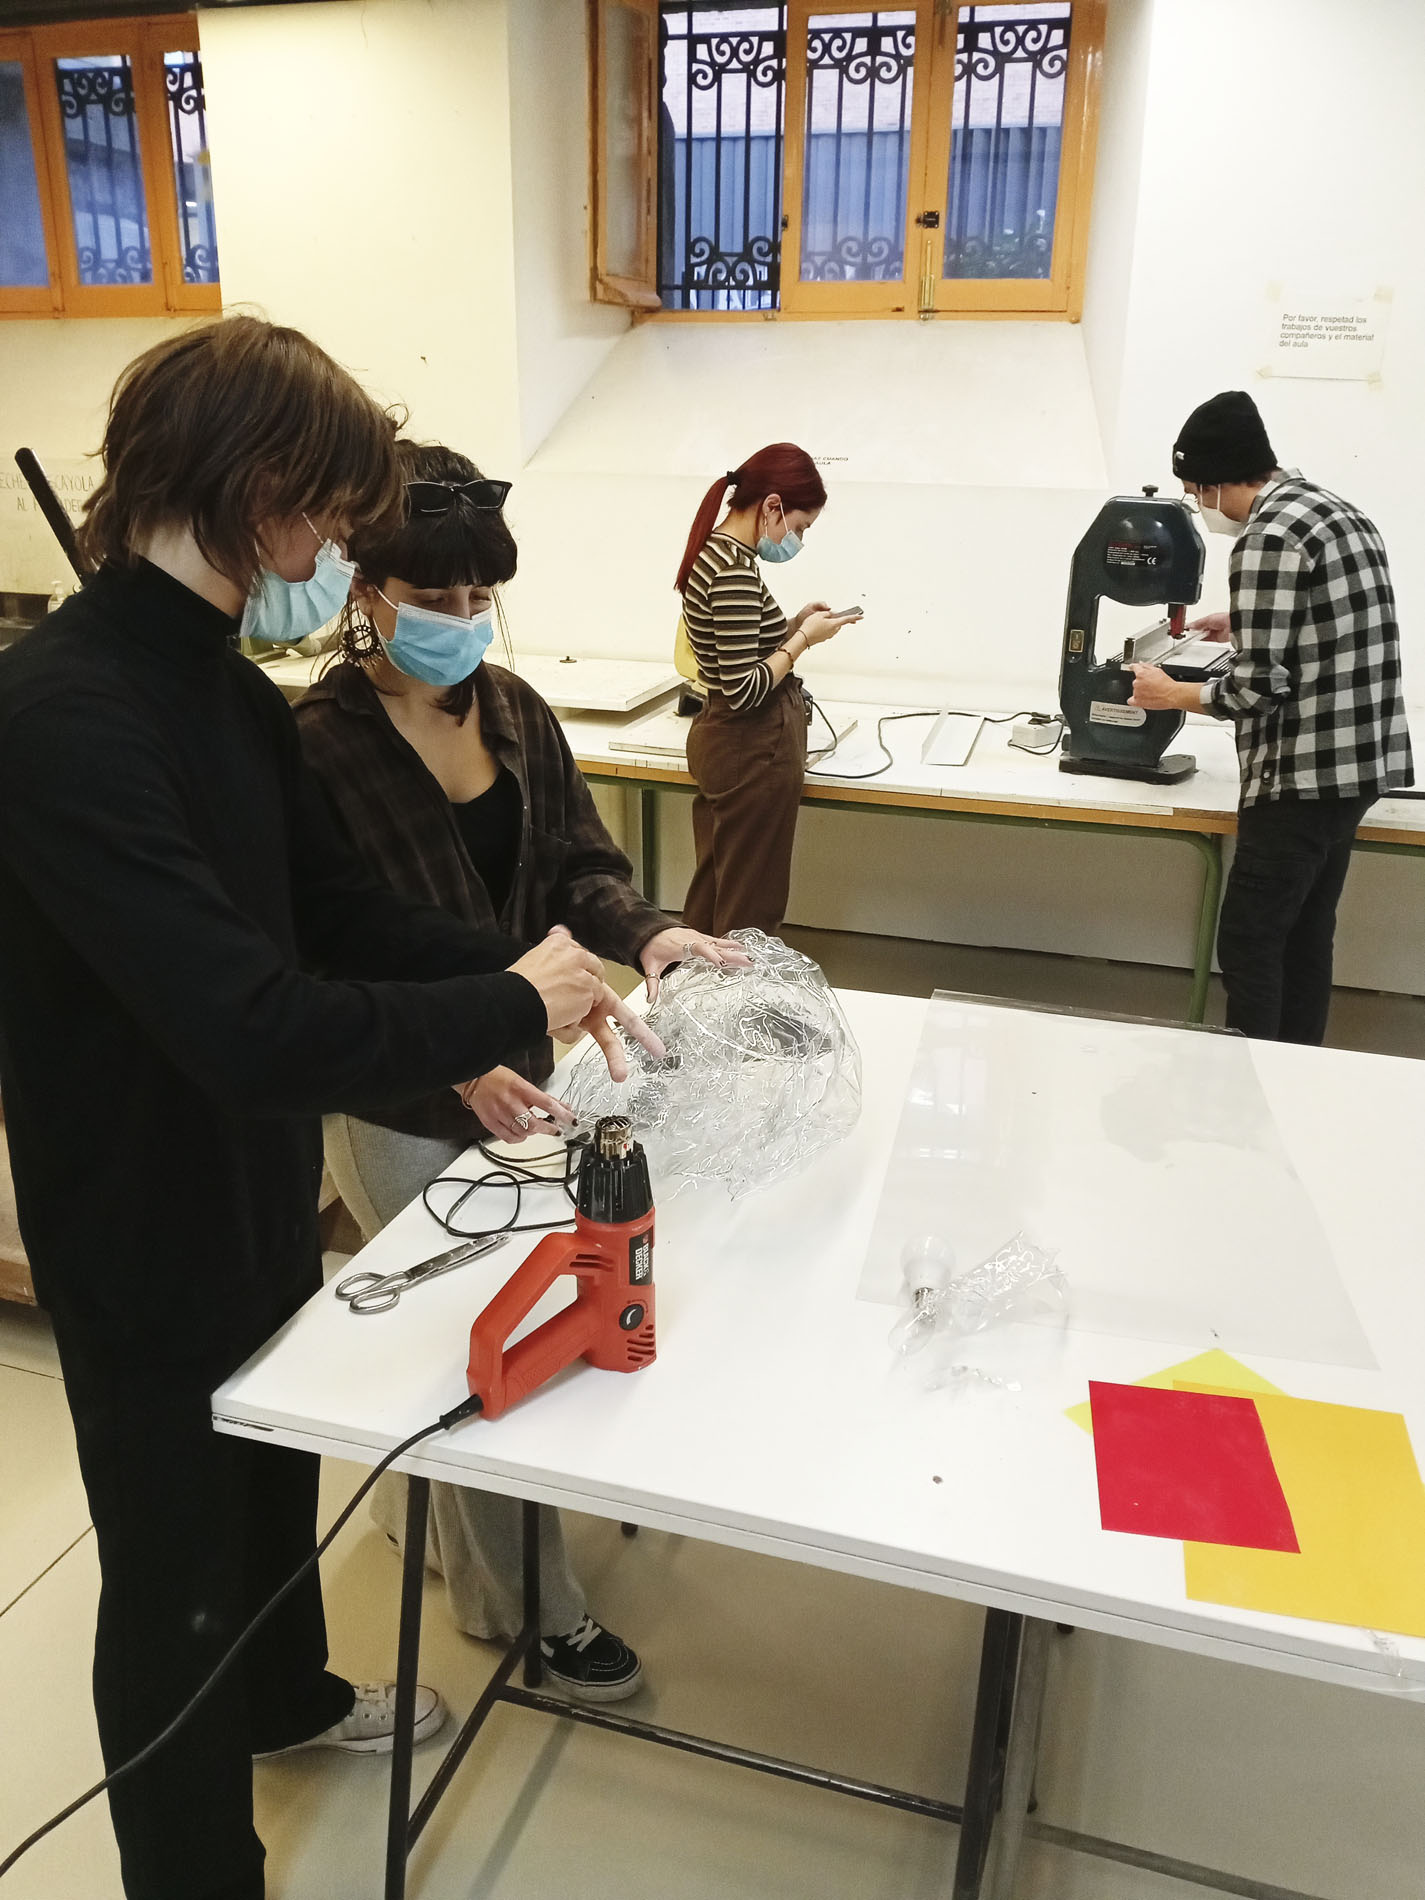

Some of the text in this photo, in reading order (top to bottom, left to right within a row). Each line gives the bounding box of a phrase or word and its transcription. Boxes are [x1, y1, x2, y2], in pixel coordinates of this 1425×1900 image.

[1282, 313, 1297, 321] Por
[1320, 315, 1354, 324] respetad
[1355, 315, 1367, 323] los
[1281, 322, 1311, 332] trabajos
[1280, 331, 1326, 340] compañeros
[1343, 333, 1374, 341] material
[1279, 339, 1309, 348] del aula
[635, 1246, 643, 1281] DECKER
